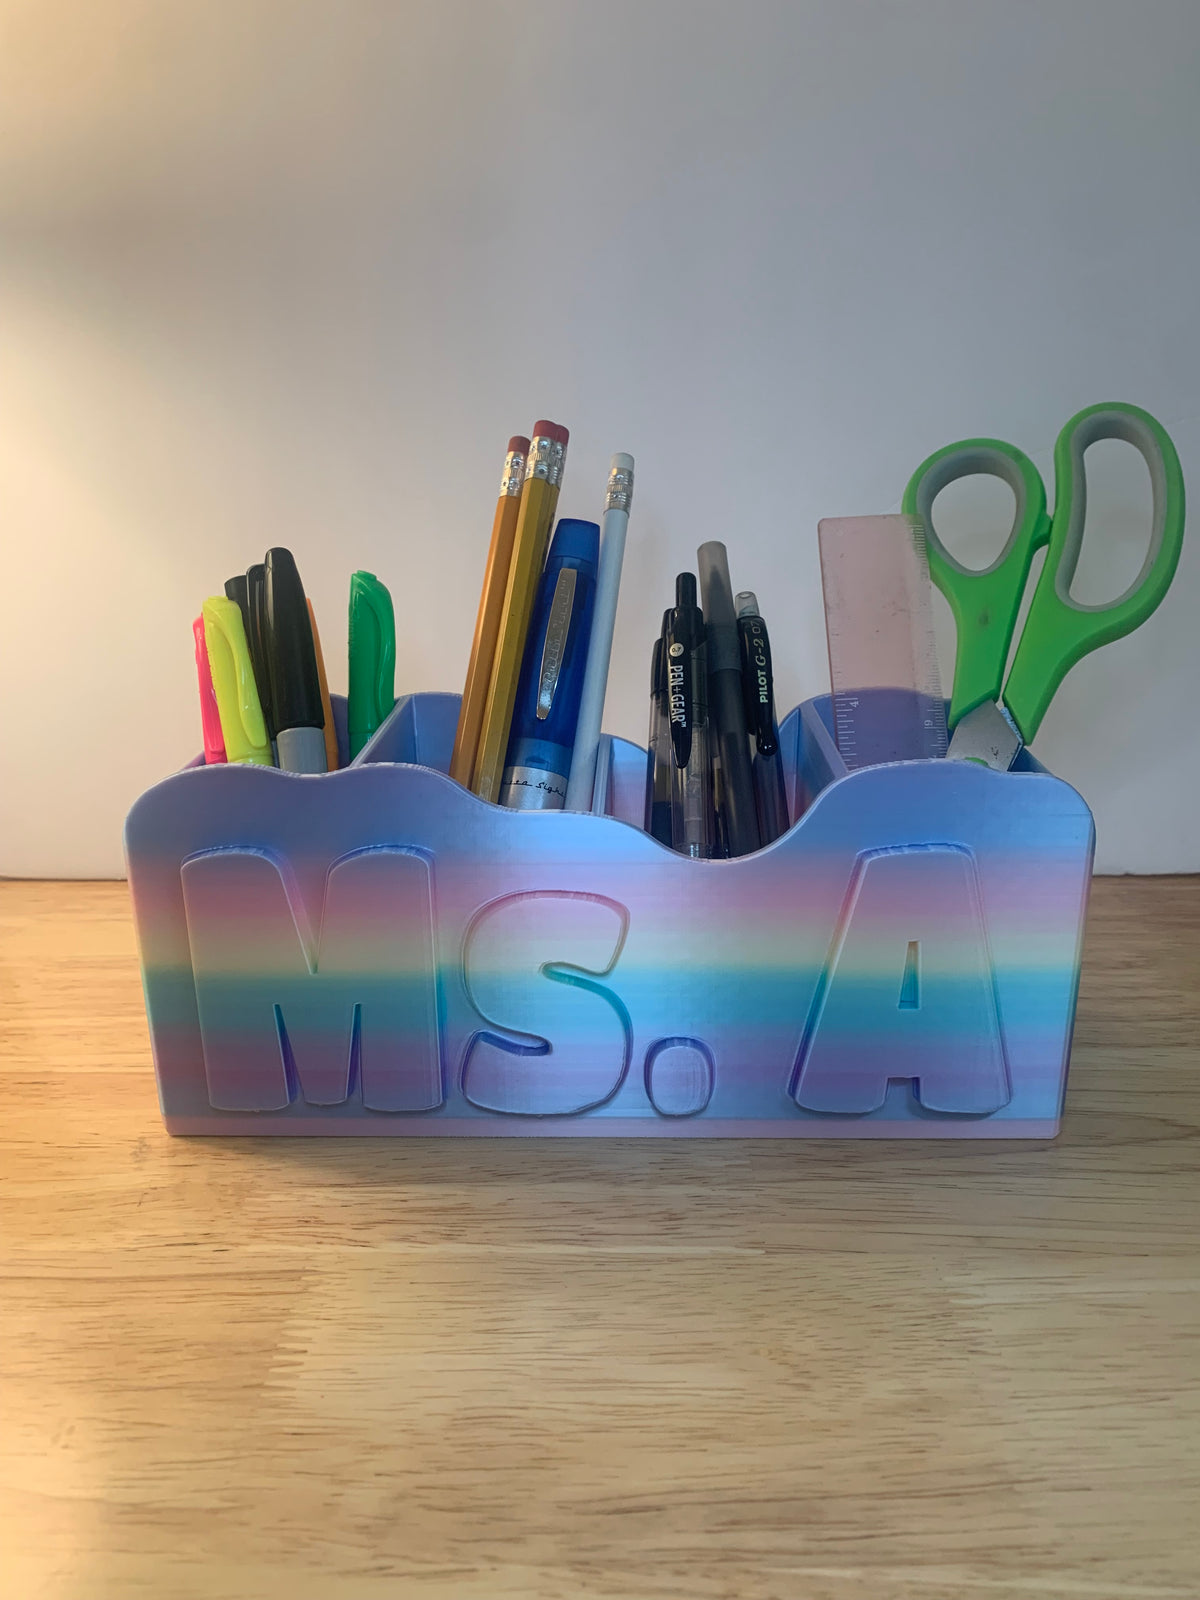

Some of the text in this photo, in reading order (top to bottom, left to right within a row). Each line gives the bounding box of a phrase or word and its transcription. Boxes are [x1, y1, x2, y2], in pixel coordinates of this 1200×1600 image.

[753, 638, 767, 667] G-2
[757, 669, 769, 704] PILOT
[180, 843, 1013, 1117] Ms. A
